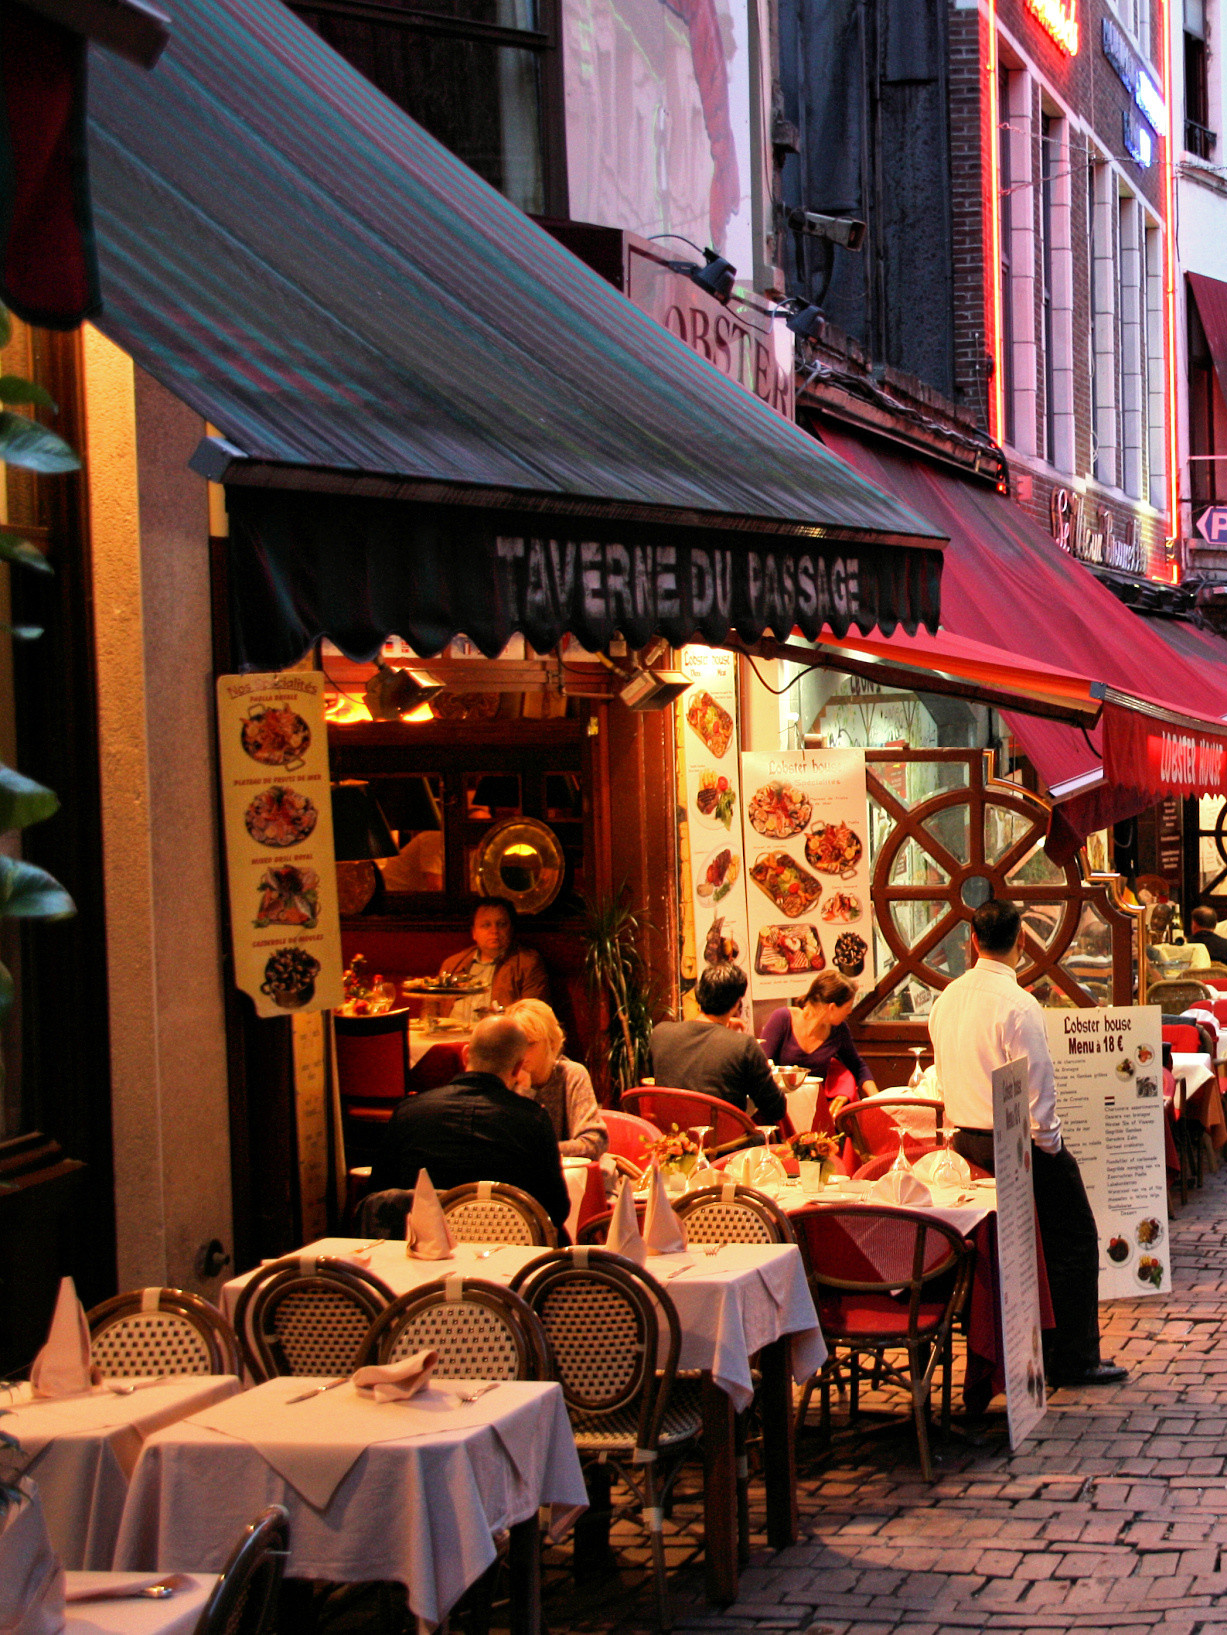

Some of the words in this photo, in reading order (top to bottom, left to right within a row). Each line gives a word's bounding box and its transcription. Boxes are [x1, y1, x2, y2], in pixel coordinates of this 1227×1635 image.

[496, 536, 681, 620] TAVERNE
[691, 548, 732, 619] DU
[748, 551, 860, 617] PASSAGE
[768, 759, 807, 775] Lobster
[1160, 731, 1197, 785] LOBSTER
[1063, 1015, 1100, 1034] Lobster
[1103, 1013, 1132, 1032] house
[1068, 1037, 1095, 1055] Menu
[1096, 1040, 1101, 1053] à
[1103, 1035, 1115, 1053] 18
[1117, 1034, 1124, 1052] €
